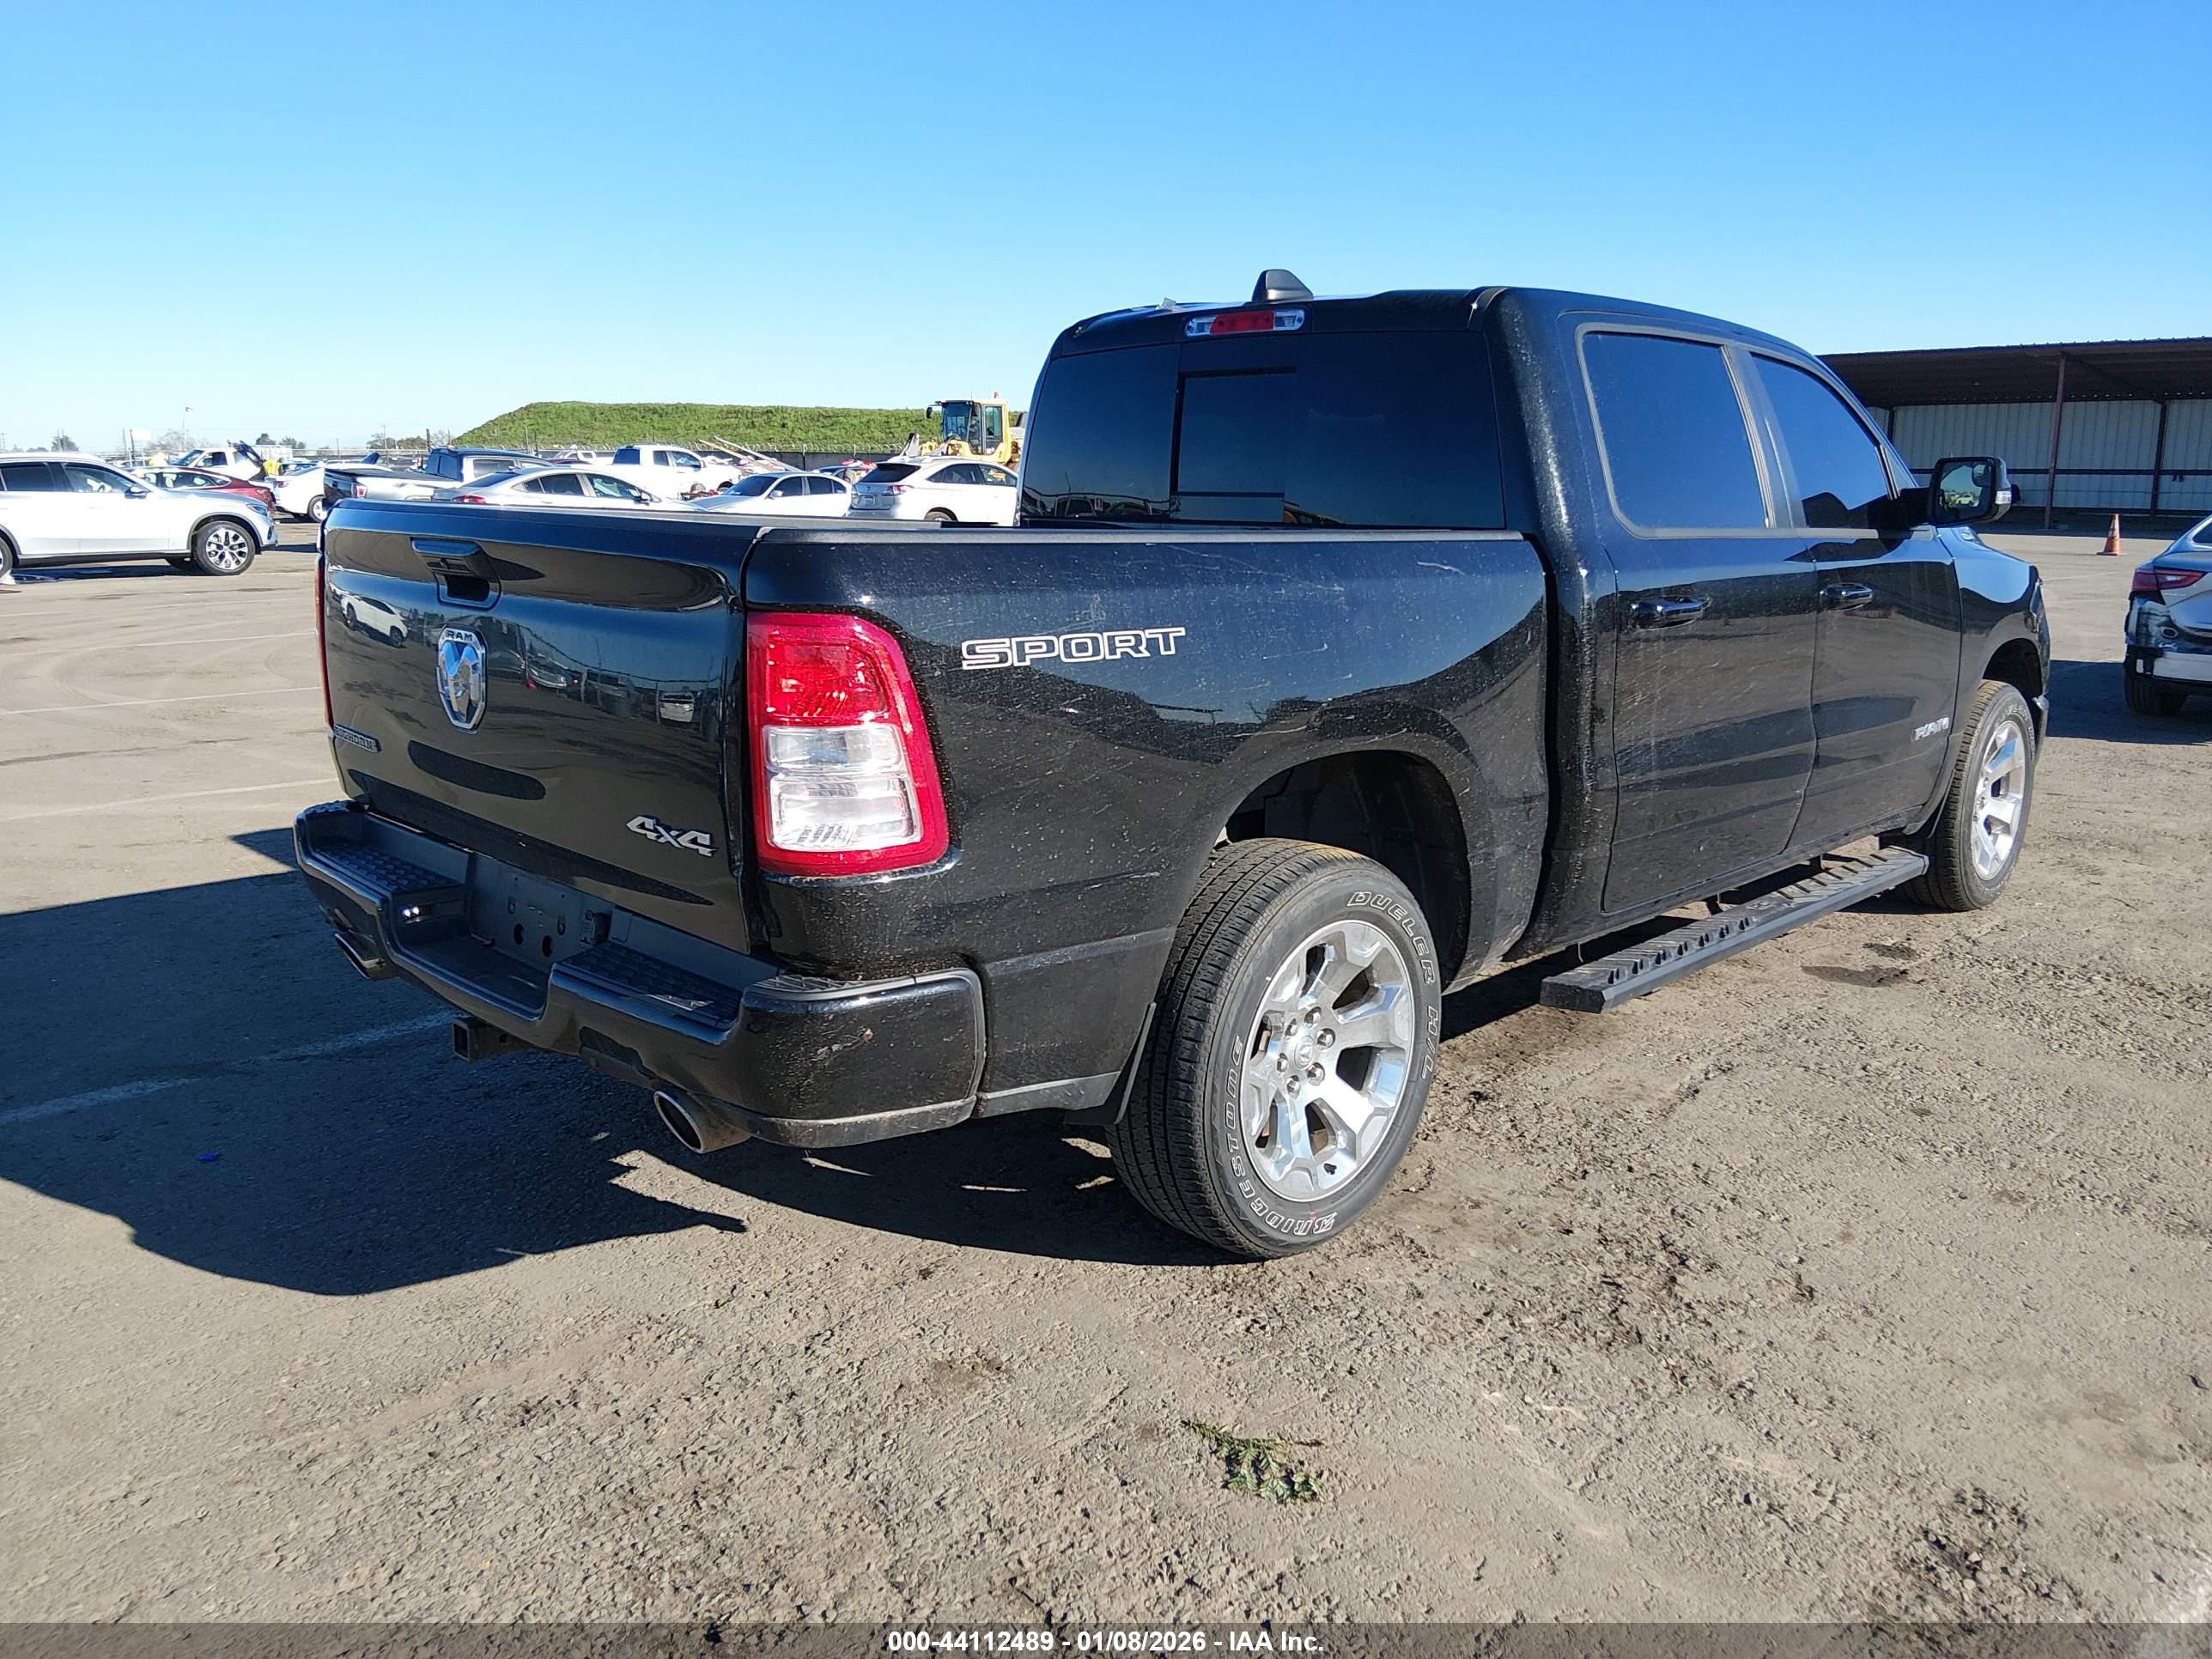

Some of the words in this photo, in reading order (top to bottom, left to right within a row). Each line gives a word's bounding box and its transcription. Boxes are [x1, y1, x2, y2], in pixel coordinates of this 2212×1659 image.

[447, 629, 473, 642] RAM
[961, 626, 1187, 671] SPORT
[1347, 890, 1436, 987] DUELER
[1224, 1034, 1338, 1237] BRIDGESTONE
